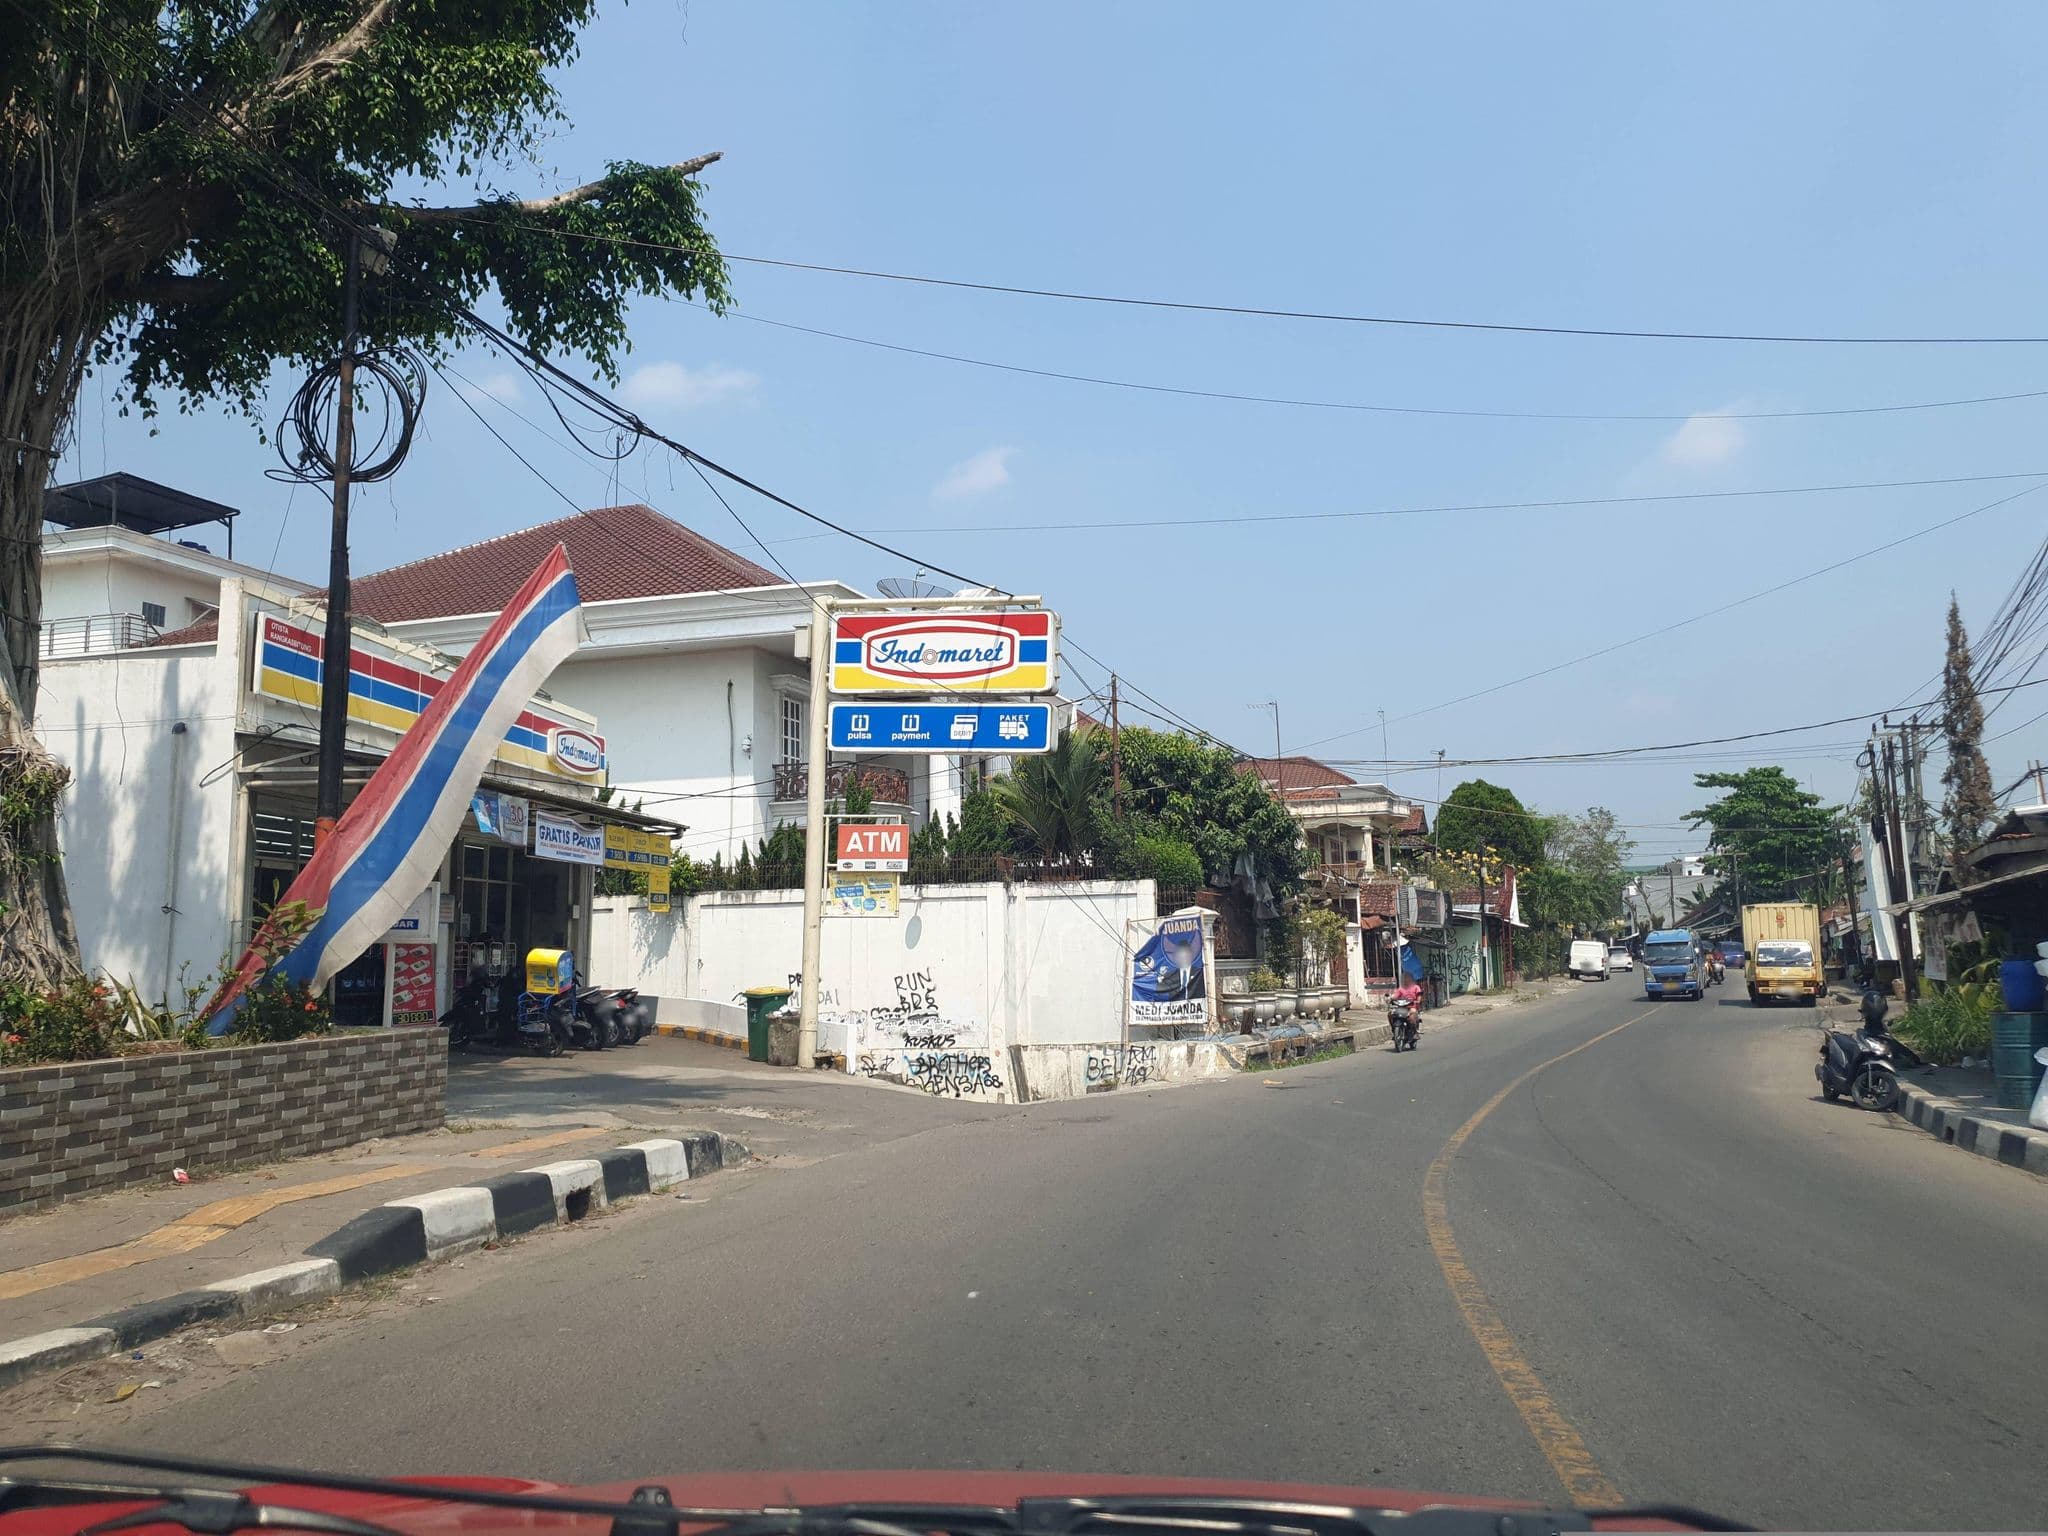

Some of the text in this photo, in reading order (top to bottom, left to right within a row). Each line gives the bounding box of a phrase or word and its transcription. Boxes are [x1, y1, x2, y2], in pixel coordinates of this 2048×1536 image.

[875, 639, 1004, 665] Indomaret
[999, 714, 1030, 722] PAKET
[847, 731, 872, 741] pulsa
[891, 731, 930, 741] payment
[539, 825, 571, 844] GRATIS
[846, 832, 900, 852] ATM
[1163, 919, 1199, 934] JUANDA
